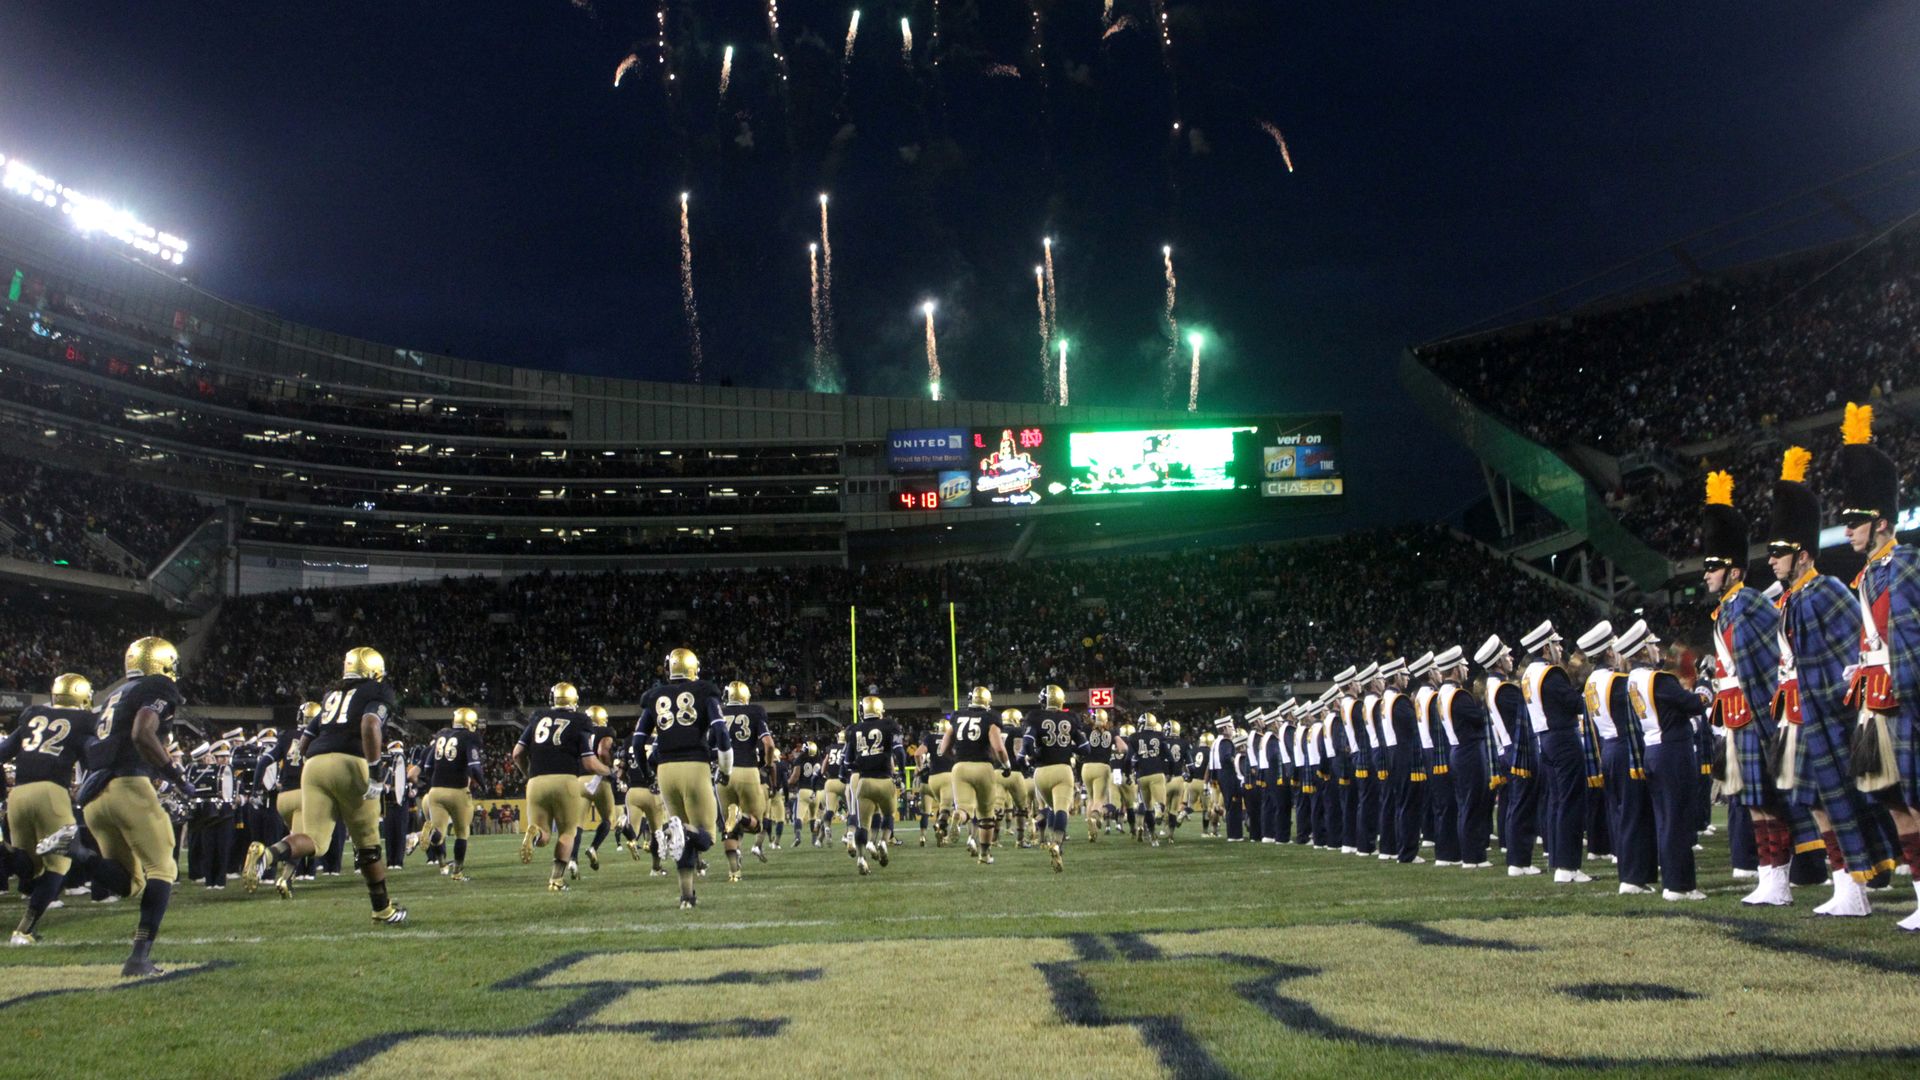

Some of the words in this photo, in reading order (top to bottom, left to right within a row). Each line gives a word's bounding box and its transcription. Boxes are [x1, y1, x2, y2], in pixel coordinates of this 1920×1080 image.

[893, 439, 946, 448] UNITED
[1277, 434, 1322, 445] verizon
[1320, 460, 1334, 470] TIME
[901, 492, 937, 508] 4:18
[1268, 482, 1319, 494] CHASE
[320, 688, 358, 725] 91
[1092, 690, 1111, 705] 25
[97, 691, 122, 740] 5
[655, 691, 698, 731] 88
[21, 715, 71, 757] 32
[534, 716, 571, 746] 67
[723, 713, 752, 742] 73
[956, 716, 982, 742] 75
[1041, 719, 1072, 748] 38
[1089, 729, 1112, 748] 69
[855, 728, 884, 757] 42
[1138, 737, 1160, 759] 43
